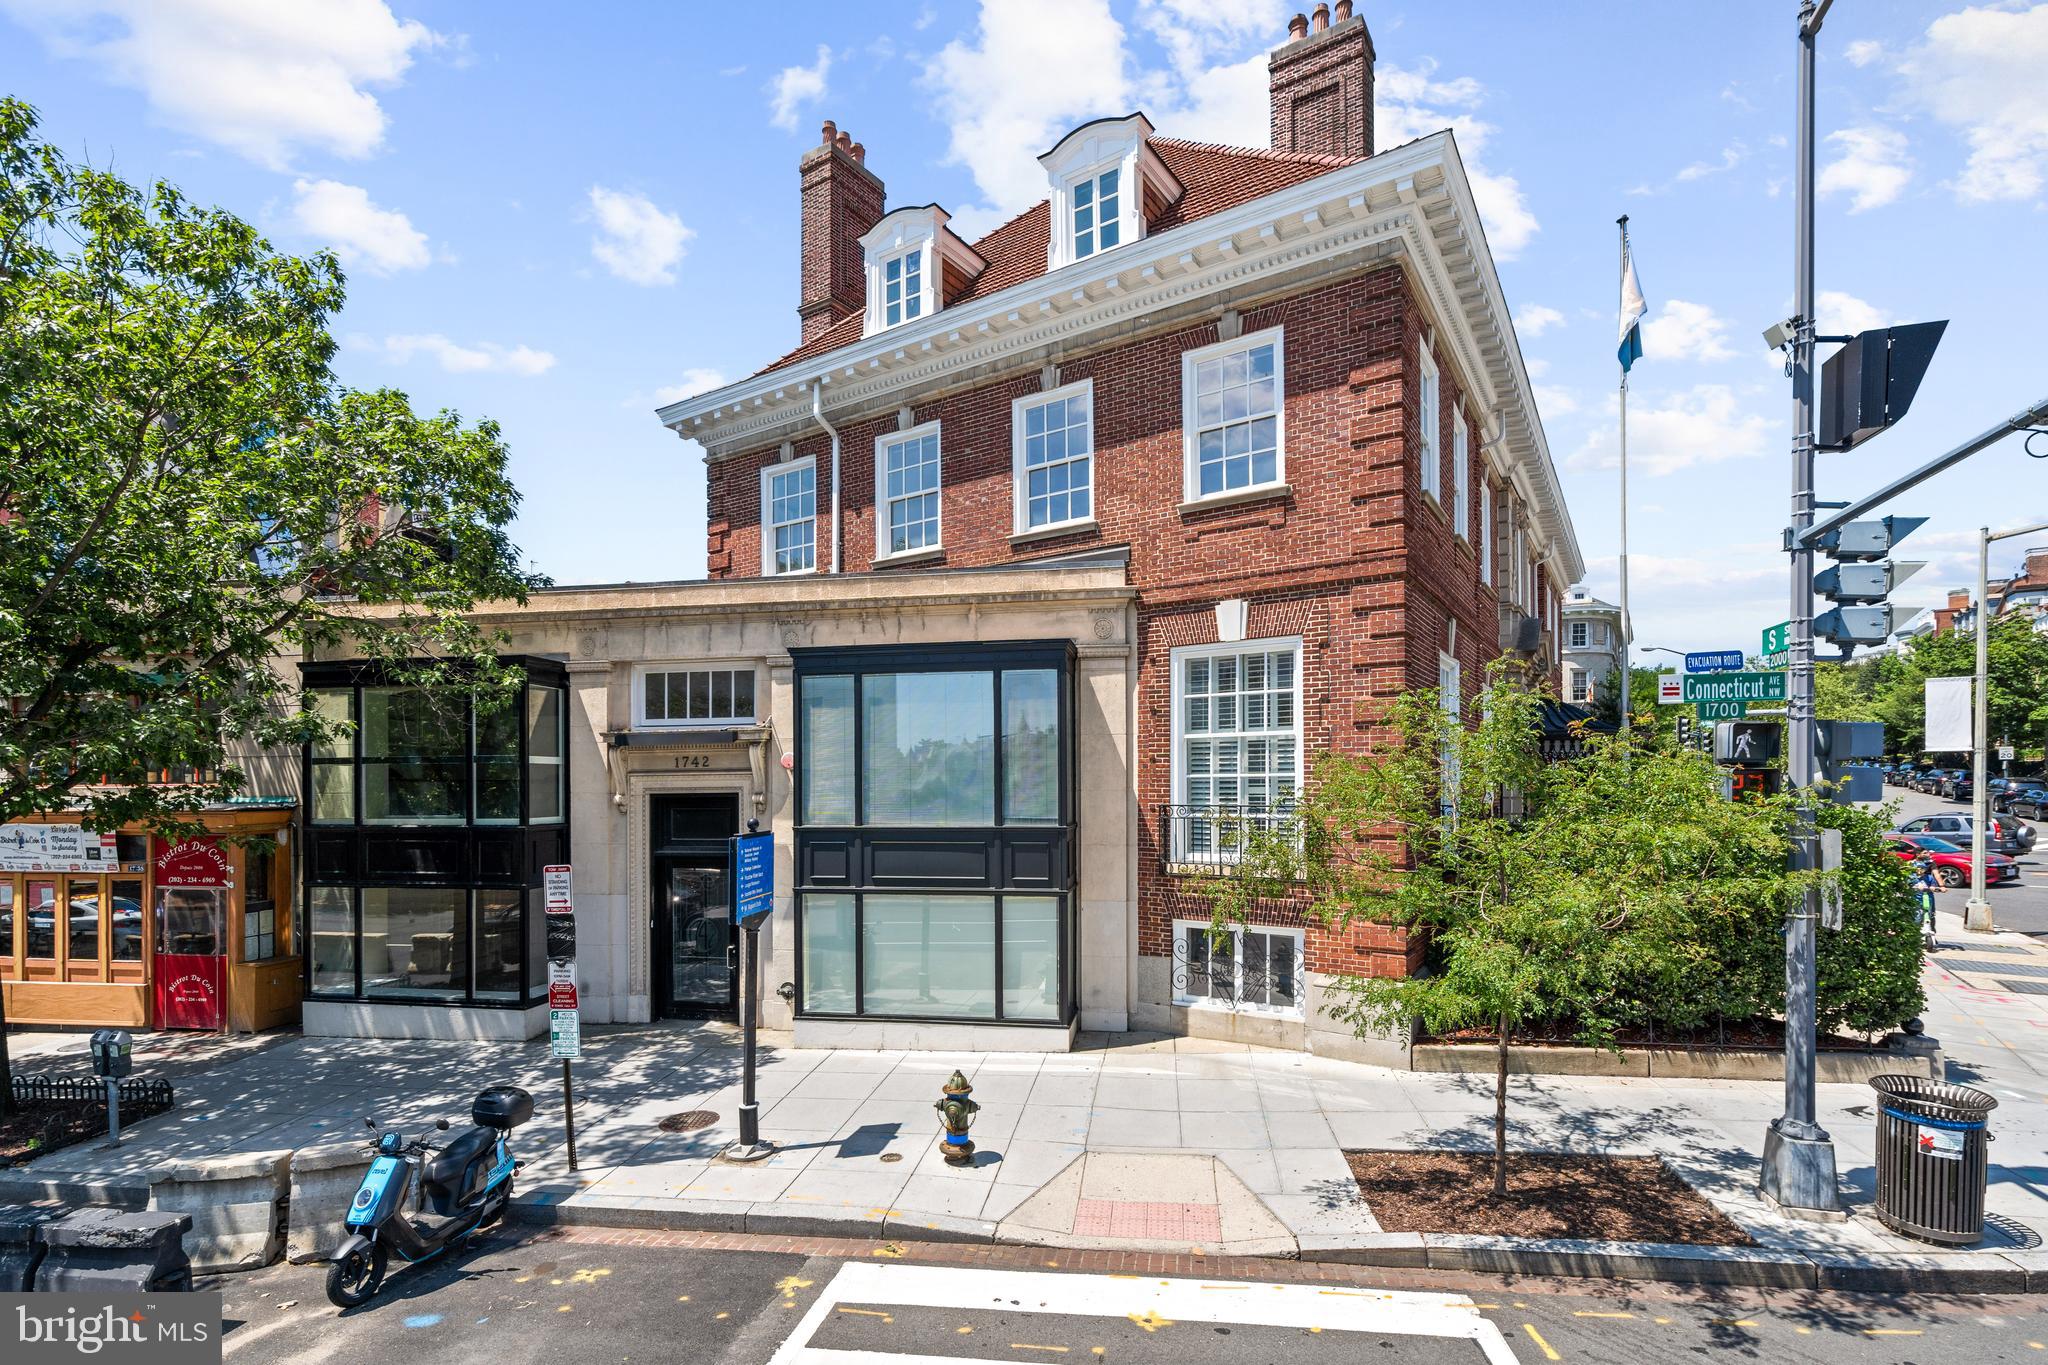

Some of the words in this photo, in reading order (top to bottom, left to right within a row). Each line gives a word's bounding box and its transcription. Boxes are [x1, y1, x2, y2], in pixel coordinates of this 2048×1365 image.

[1768, 630, 1776, 650] S
[1688, 656, 1721, 668] EVACUATION
[1723, 655, 1741, 666] ROUTE
[1770, 651, 1787, 667] 2000
[1687, 678, 1765, 700] Connecticut
[1769, 676, 1780, 685] AVE
[1769, 688, 1780, 697] NW
[1705, 703, 1739, 717] 1700
[674, 756, 710, 768] 1742
[51, 835, 78, 845] Monday
[159, 842, 188, 870] Bistrot
[191, 841, 206, 852] Du
[208, 848, 226, 871] Coin
[169, 975, 189, 993] Bistrot
